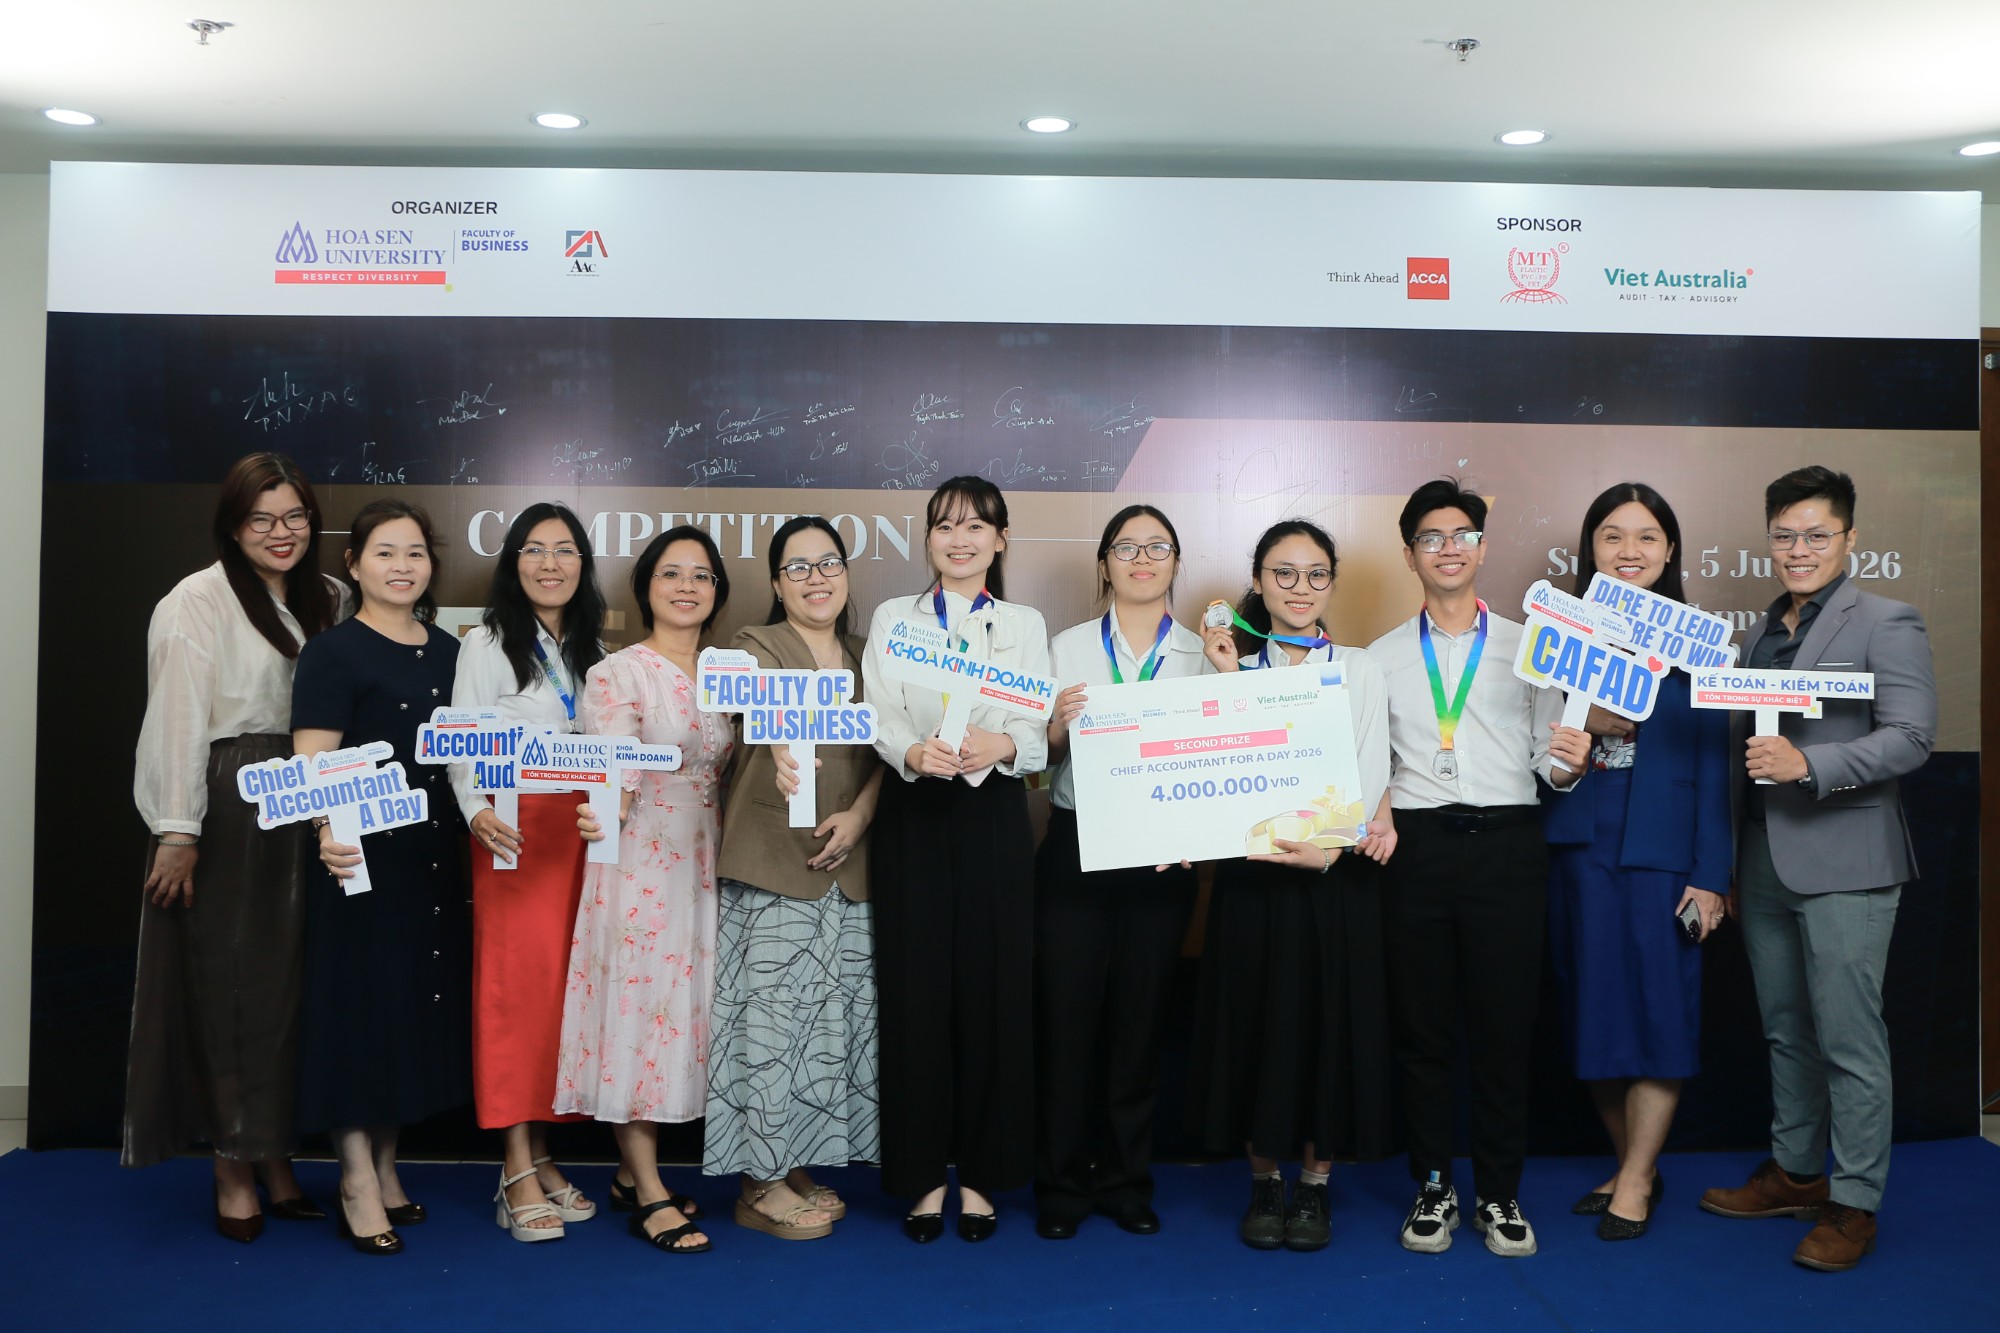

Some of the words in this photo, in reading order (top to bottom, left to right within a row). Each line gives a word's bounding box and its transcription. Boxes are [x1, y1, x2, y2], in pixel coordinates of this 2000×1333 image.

[391, 200, 498, 215] ORGANIZER
[1496, 217, 1582, 232] SPONSOR
[325, 229, 370, 245] HOA
[375, 229, 413, 245] SEN
[461, 229, 501, 238] FACULTY
[503, 230, 516, 238] OF
[461, 240, 529, 252] BUSINESS
[325, 249, 446, 265] UNIVERSITY
[1516, 251, 1551, 266] MT
[302, 273, 353, 281] RESPECT
[357, 273, 419, 281] DIVERSITY
[1327, 272, 1361, 283] Think
[1363, 272, 1399, 283] Ahead
[1408, 272, 1448, 285] ACCA
[1603, 268, 1649, 287] Viet
[1653, 269, 1747, 289] Australia
[1659, 294, 1676, 302] TAX
[1689, 295, 1738, 303] ADVISORY
[1700, 545, 1720, 578] 5
[1552, 595, 1570, 608] HOA
[1569, 602, 1586, 614] SEN
[1551, 604, 1596, 627] UNIVERSITY
[1594, 579, 1646, 618] DARE
[1647, 598, 1678, 628] TO
[1673, 609, 1726, 648] LEAD
[909, 633, 926, 644] HOA
[1658, 631, 1684, 659] TO
[1686, 641, 1728, 667] WIN
[886, 639, 938, 667] KHOA
[941, 654, 985, 680] KINH
[985, 666, 1053, 698] DOANH
[1531, 625, 1653, 714] CAFAD
[703, 674, 808, 706] FACULTY
[817, 675, 847, 707] OF
[1697, 673, 1717, 688] KẾ
[1721, 675, 1766, 690] TOÁN
[1780, 675, 1820, 692] KIỂM
[1824, 678, 1870, 694] TOÁN
[1257, 696, 1277, 705] Viet
[1278, 691, 1318, 703] Australia
[1704, 693, 1721, 701] TÔN
[1722, 694, 1749, 703] TRỌNG
[1751, 694, 1762, 704] SỰ
[1763, 694, 1784, 704] KHÁC
[1786, 696, 1803, 706] BIỆT
[751, 709, 872, 741] BUSINESS
[1096, 718, 1138, 728] UNIVERSITY
[421, 725, 527, 758] Account
[1173, 738, 1219, 751] SECOND
[1220, 735, 1251, 747] PRIZE
[552, 756, 581, 768] HOA
[583, 758, 607, 769] SEN
[615, 752, 638, 761] KINH
[639, 754, 673, 763] DOANH
[1110, 764, 1144, 777] CHIEF
[1146, 756, 1227, 773] ACCOUNTANT
[1229, 753, 1254, 765] FOR
[1256, 752, 1266, 763] A
[1267, 750, 1291, 761] DAY
[1294, 747, 1323, 759] 2026
[244, 759, 307, 797] Chief
[264, 768, 402, 821] Accountant
[1151, 774, 1268, 802] 4.000.000
[1269, 776, 1300, 788] VND
[359, 803, 376, 829] A
[379, 794, 422, 825] Day
